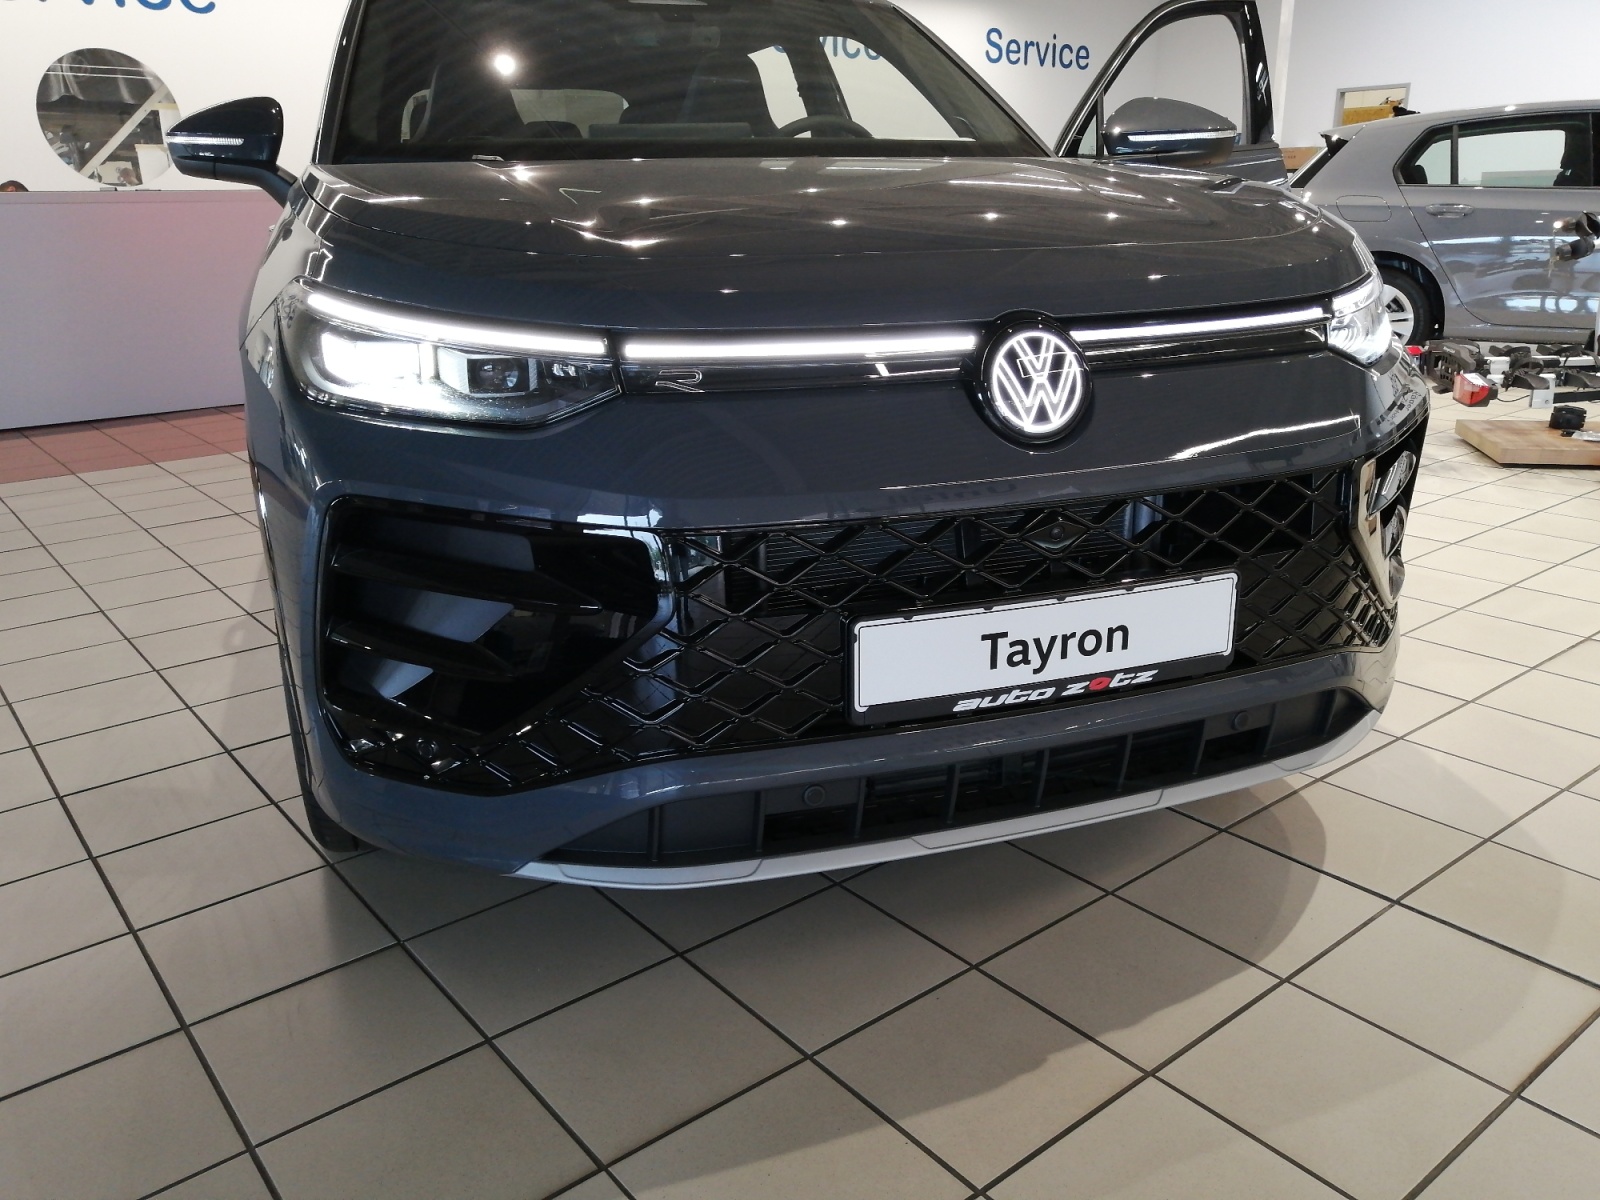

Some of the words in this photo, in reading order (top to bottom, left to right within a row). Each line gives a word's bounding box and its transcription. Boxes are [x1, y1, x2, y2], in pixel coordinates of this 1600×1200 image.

[985, 27, 1090, 70] Service
[981, 623, 1130, 675] Tayron
[952, 686, 1056, 712] auto
[1061, 669, 1159, 697] zotz
